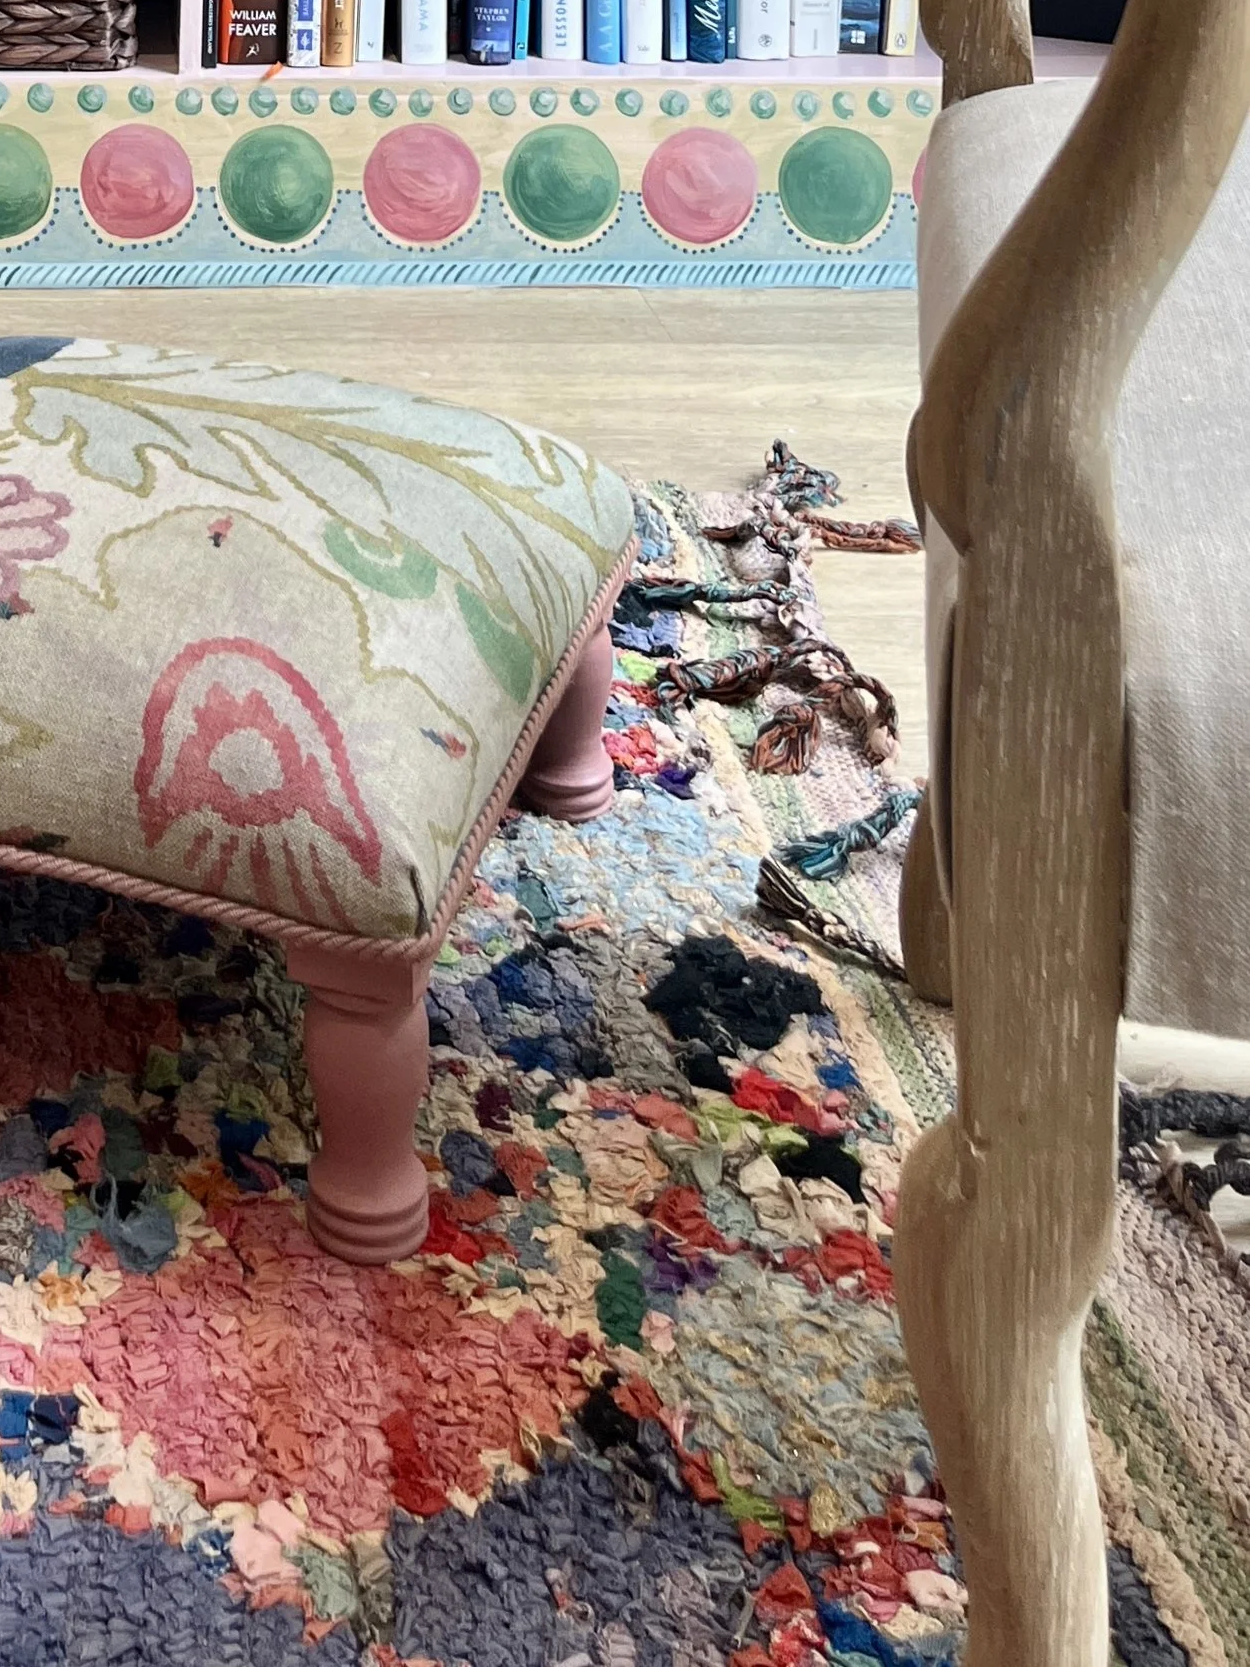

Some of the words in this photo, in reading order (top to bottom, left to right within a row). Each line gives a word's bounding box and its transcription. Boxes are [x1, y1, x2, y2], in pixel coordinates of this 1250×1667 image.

[229, 10, 277, 20] WILLIAM
[476, 14, 507, 22] TAYLOR
[228, 23, 277, 36] FEAVER
